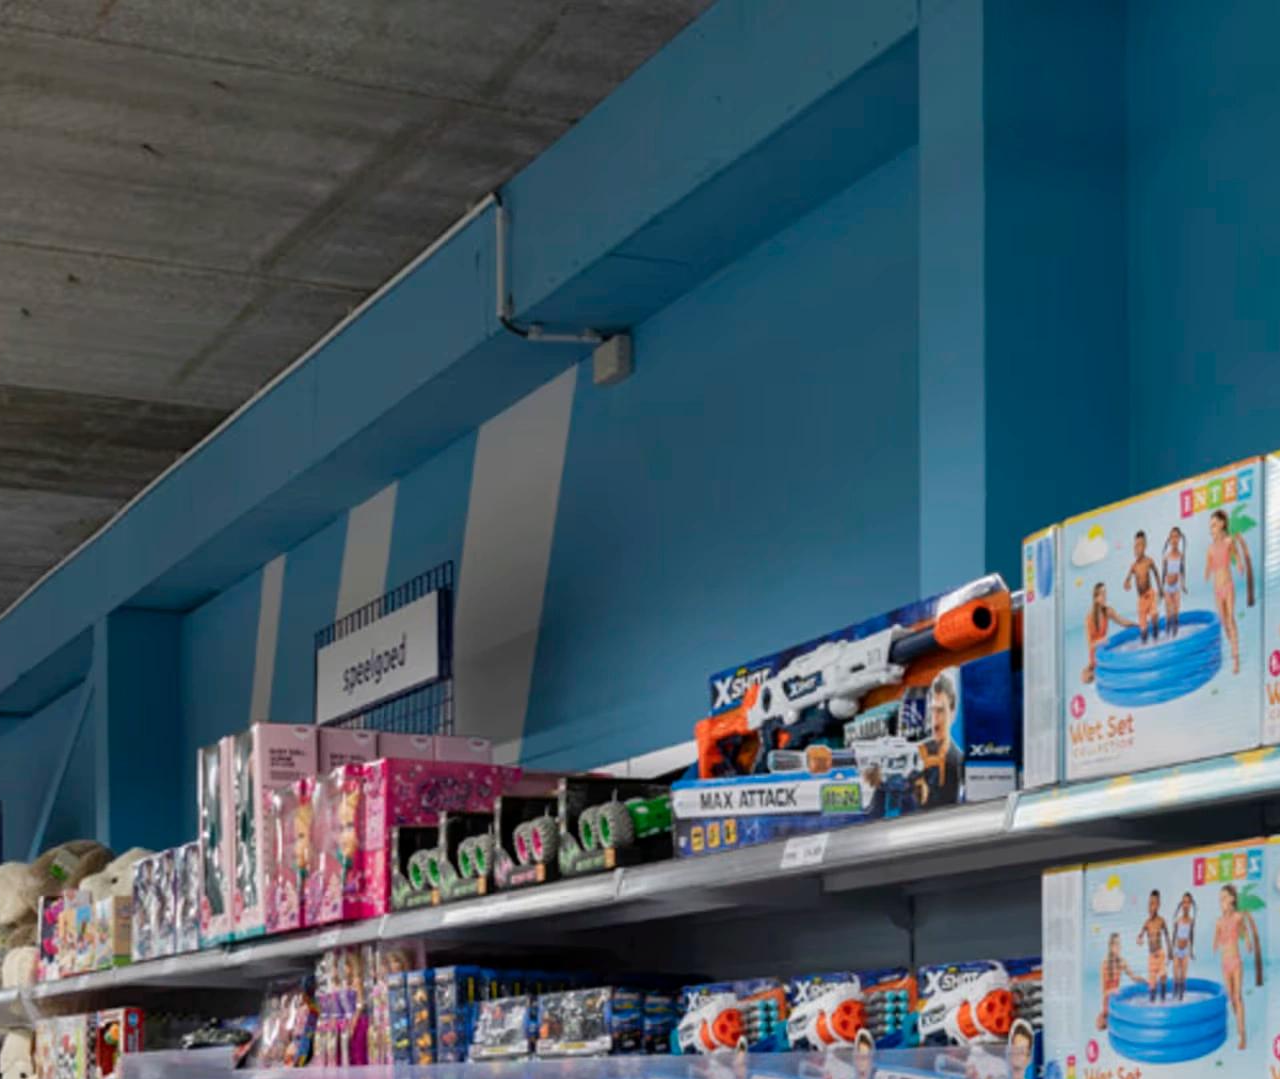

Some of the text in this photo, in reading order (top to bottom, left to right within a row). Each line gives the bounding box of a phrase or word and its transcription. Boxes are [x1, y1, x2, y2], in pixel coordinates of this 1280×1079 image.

[1181, 470, 1253, 518] INTEX
[342, 631, 407, 696] speelgoed
[1070, 714, 1135, 745] Wet Set
[700, 791, 734, 810] MAX
[739, 787, 798, 809] ATTACK
[1193, 850, 1264, 885] INTEX
